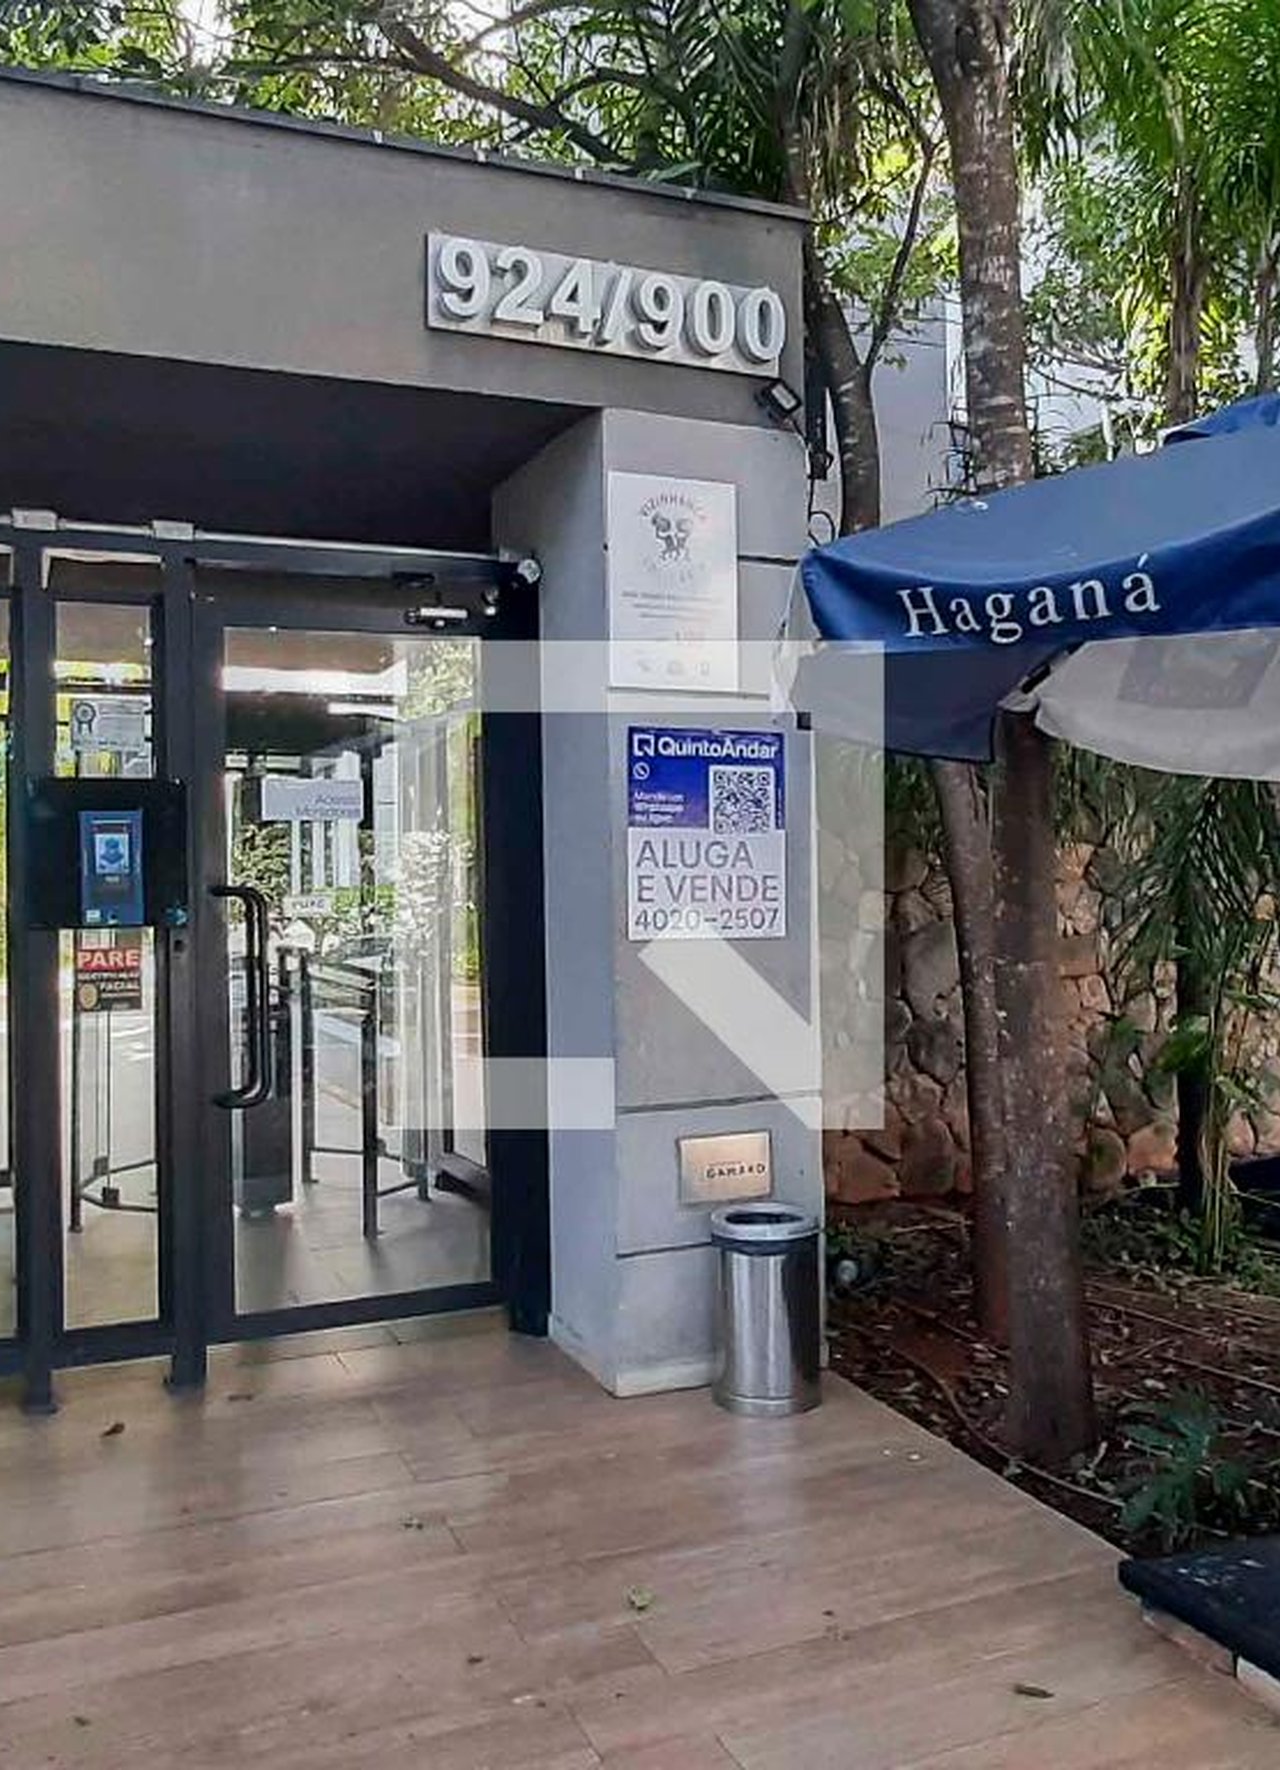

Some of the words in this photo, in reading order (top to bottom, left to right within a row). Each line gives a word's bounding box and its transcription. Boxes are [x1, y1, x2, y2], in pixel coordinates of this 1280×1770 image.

[438, 240, 786, 362] 924/900
[896, 553, 1160, 644] Haganá
[657, 736, 779, 759] QuintoAndar
[636, 839, 754, 869] ALUGA
[637, 875, 655, 903] E
[665, 875, 780, 903] VENDE
[634, 908, 780, 932] 4020-2507
[78, 949, 140, 970] PARE
